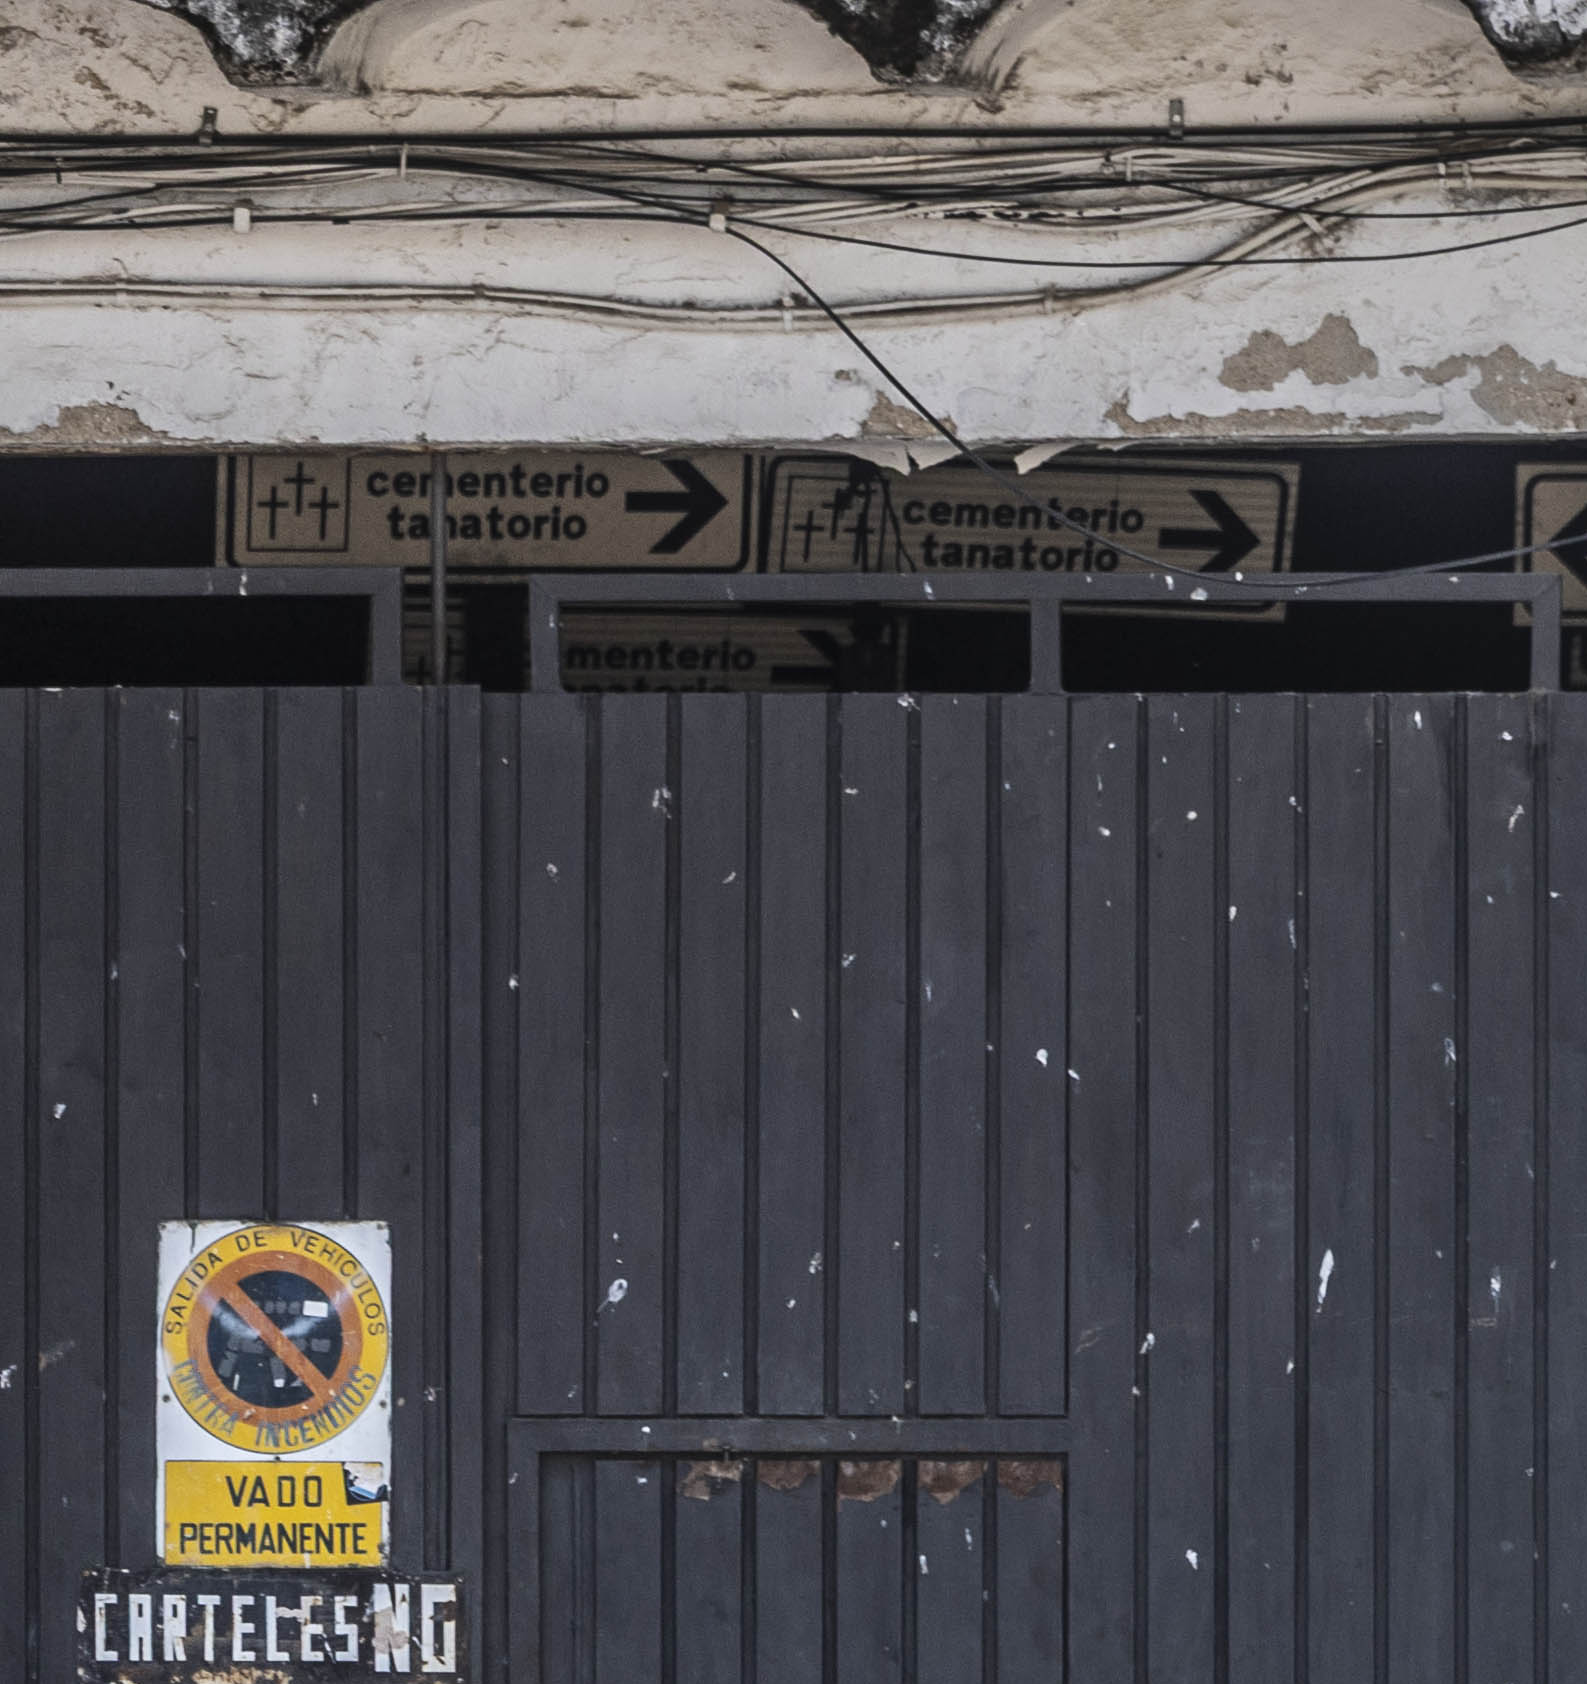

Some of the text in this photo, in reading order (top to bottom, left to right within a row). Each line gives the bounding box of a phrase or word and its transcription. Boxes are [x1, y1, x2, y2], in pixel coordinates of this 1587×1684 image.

[903, 497, 1144, 534] cementerio
[921, 532, 1120, 573] tanatorio
[165, 1230, 386, 1337] SALIDA DE VEHICULOS
[225, 1475, 323, 1509] VADO
[179, 1522, 367, 1555] PERMANENTE
[94, 1593, 359, 1662] CARTELES
